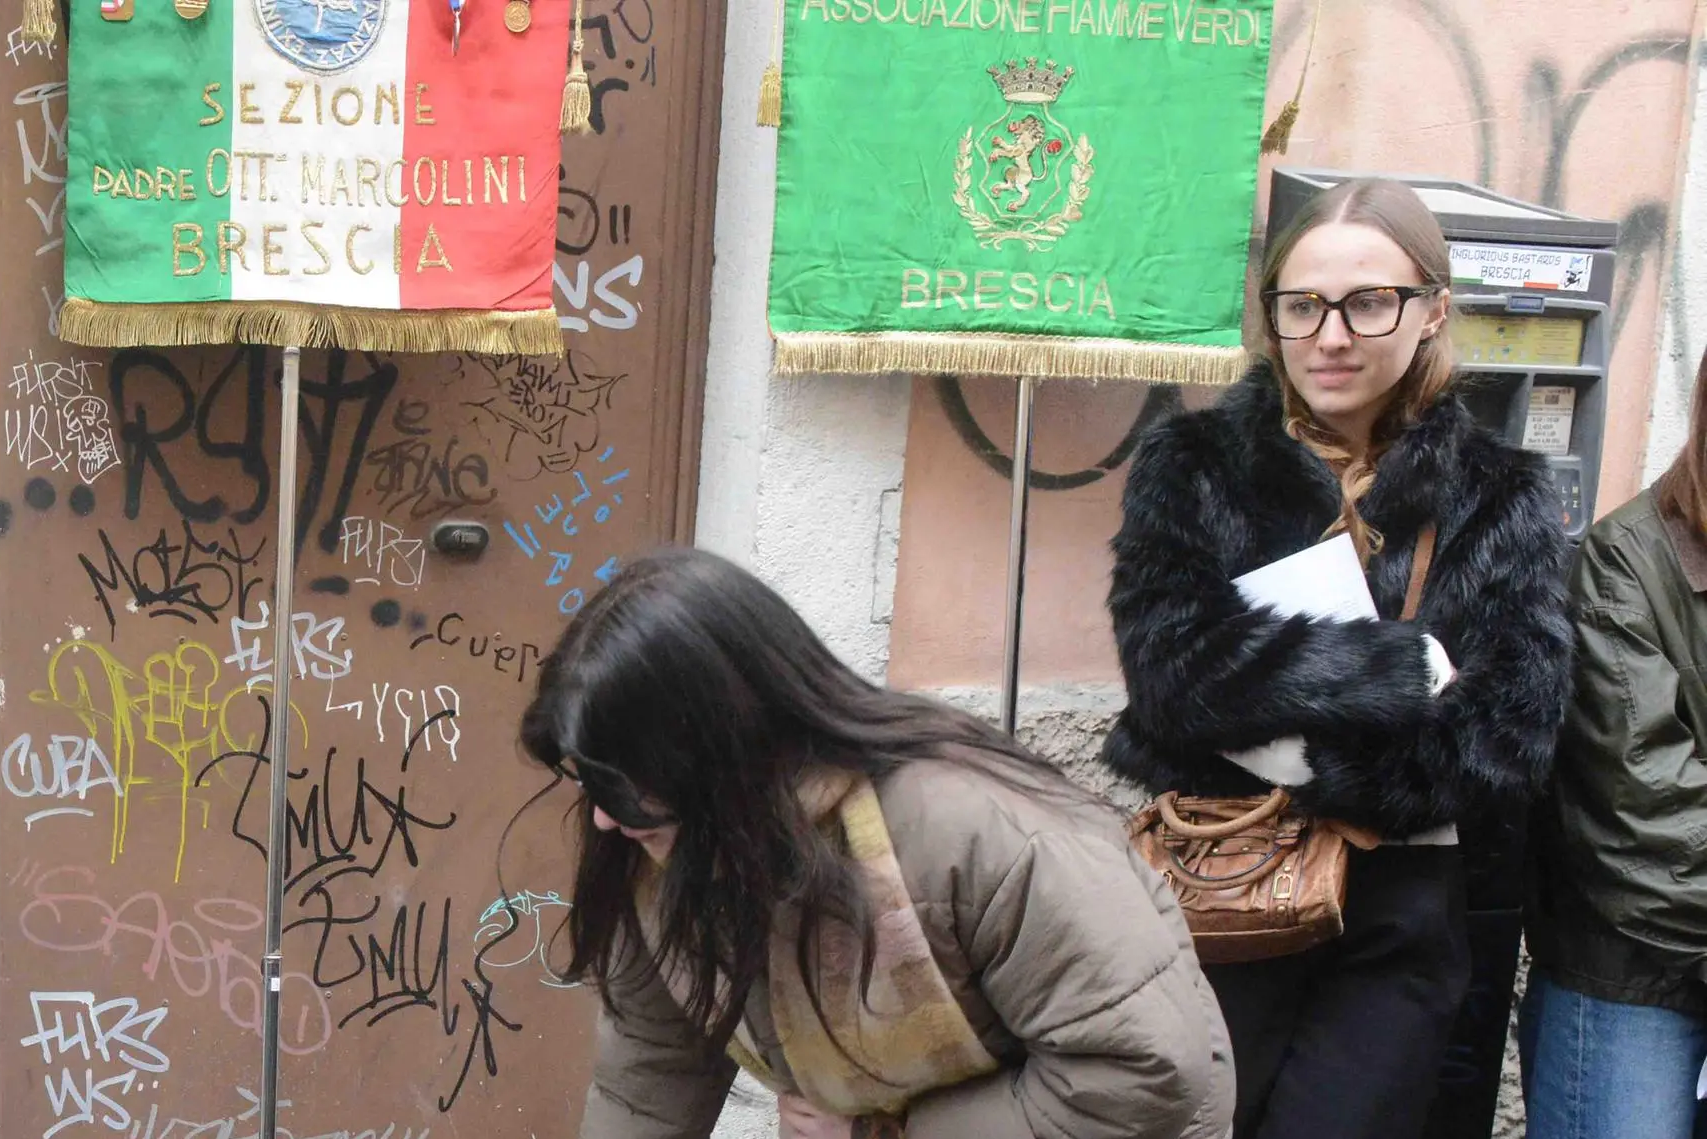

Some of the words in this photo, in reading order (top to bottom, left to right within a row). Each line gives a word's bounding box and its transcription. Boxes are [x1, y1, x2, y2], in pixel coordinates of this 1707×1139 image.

[1046, 0, 1166, 40] FIAMME
[1167, 4, 1263, 47] VERDI
[199, 80, 437, 127] SEZIONE
[93, 165, 197, 201] PADRE
[299, 153, 527, 208] MARCOLINI
[172, 222, 455, 278] BRESCIA
[1480, 265, 1532, 281] BRESCIA
[1512, 252, 1562, 266] BASTARDS
[899, 266, 1117, 321] BRESCIA
